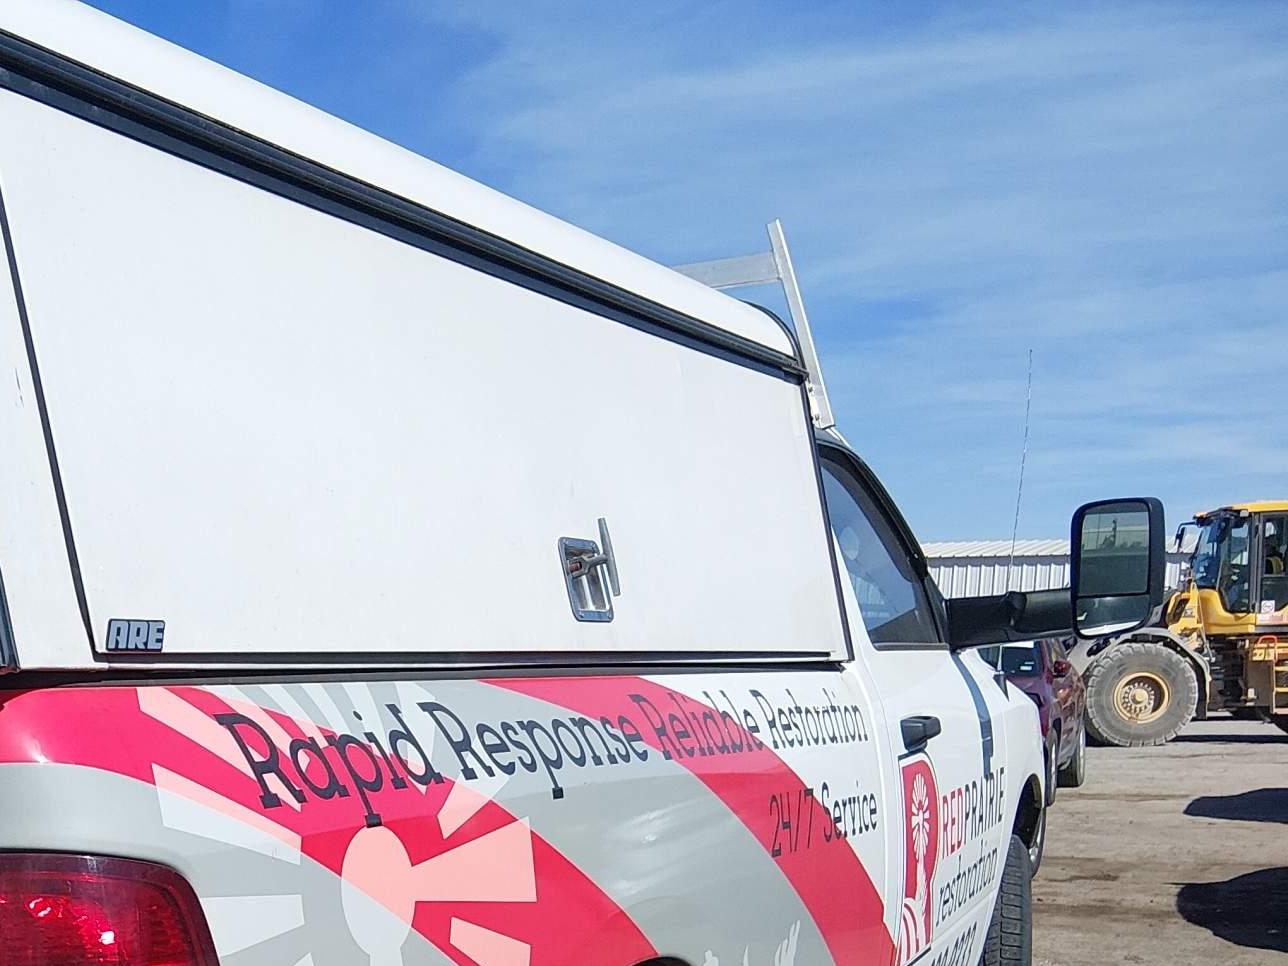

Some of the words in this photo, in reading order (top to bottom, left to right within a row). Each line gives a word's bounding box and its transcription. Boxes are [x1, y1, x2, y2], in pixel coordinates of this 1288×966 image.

[108, 621, 164, 650] ARE
[216, 701, 441, 827] Rapid
[425, 700, 649, 798] Response
[631, 689, 765, 760] Reliable
[749, 687, 869, 750] Restoration
[770, 787, 814, 858] 24/7
[821, 781, 878, 842] Service
[935, 839, 998, 927] restoration
